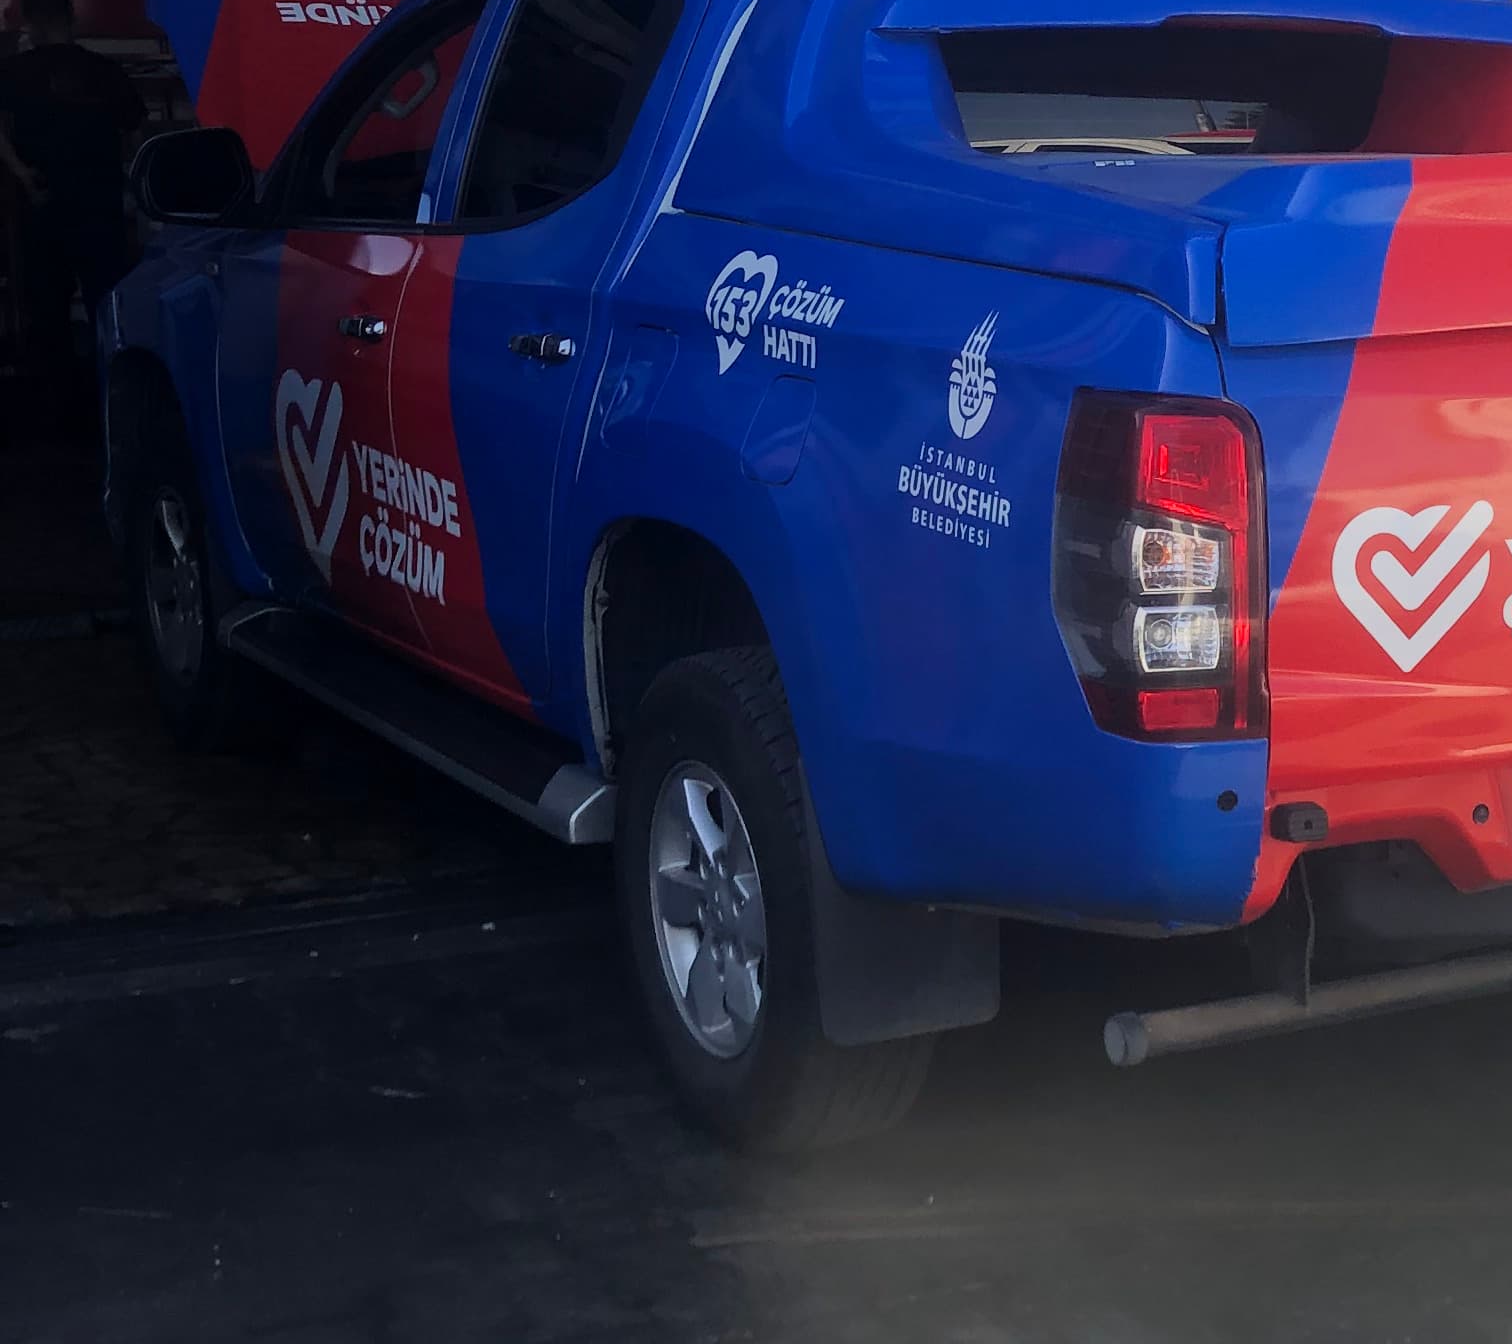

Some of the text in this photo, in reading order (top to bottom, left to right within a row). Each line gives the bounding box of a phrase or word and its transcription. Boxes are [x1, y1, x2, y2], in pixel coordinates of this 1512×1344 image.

[712, 285, 758, 337] 153
[768, 279, 845, 328] ÇÖZÜM
[763, 324, 816, 369] HATTI
[919, 441, 996, 484] İSTANBUL
[352, 440, 461, 538] YERİNDE
[898, 464, 1011, 528] BÜYÜKŞEHİR
[912, 506, 990, 549] BELEDİYESİ
[360, 507, 446, 606] ÇÖZÜM
